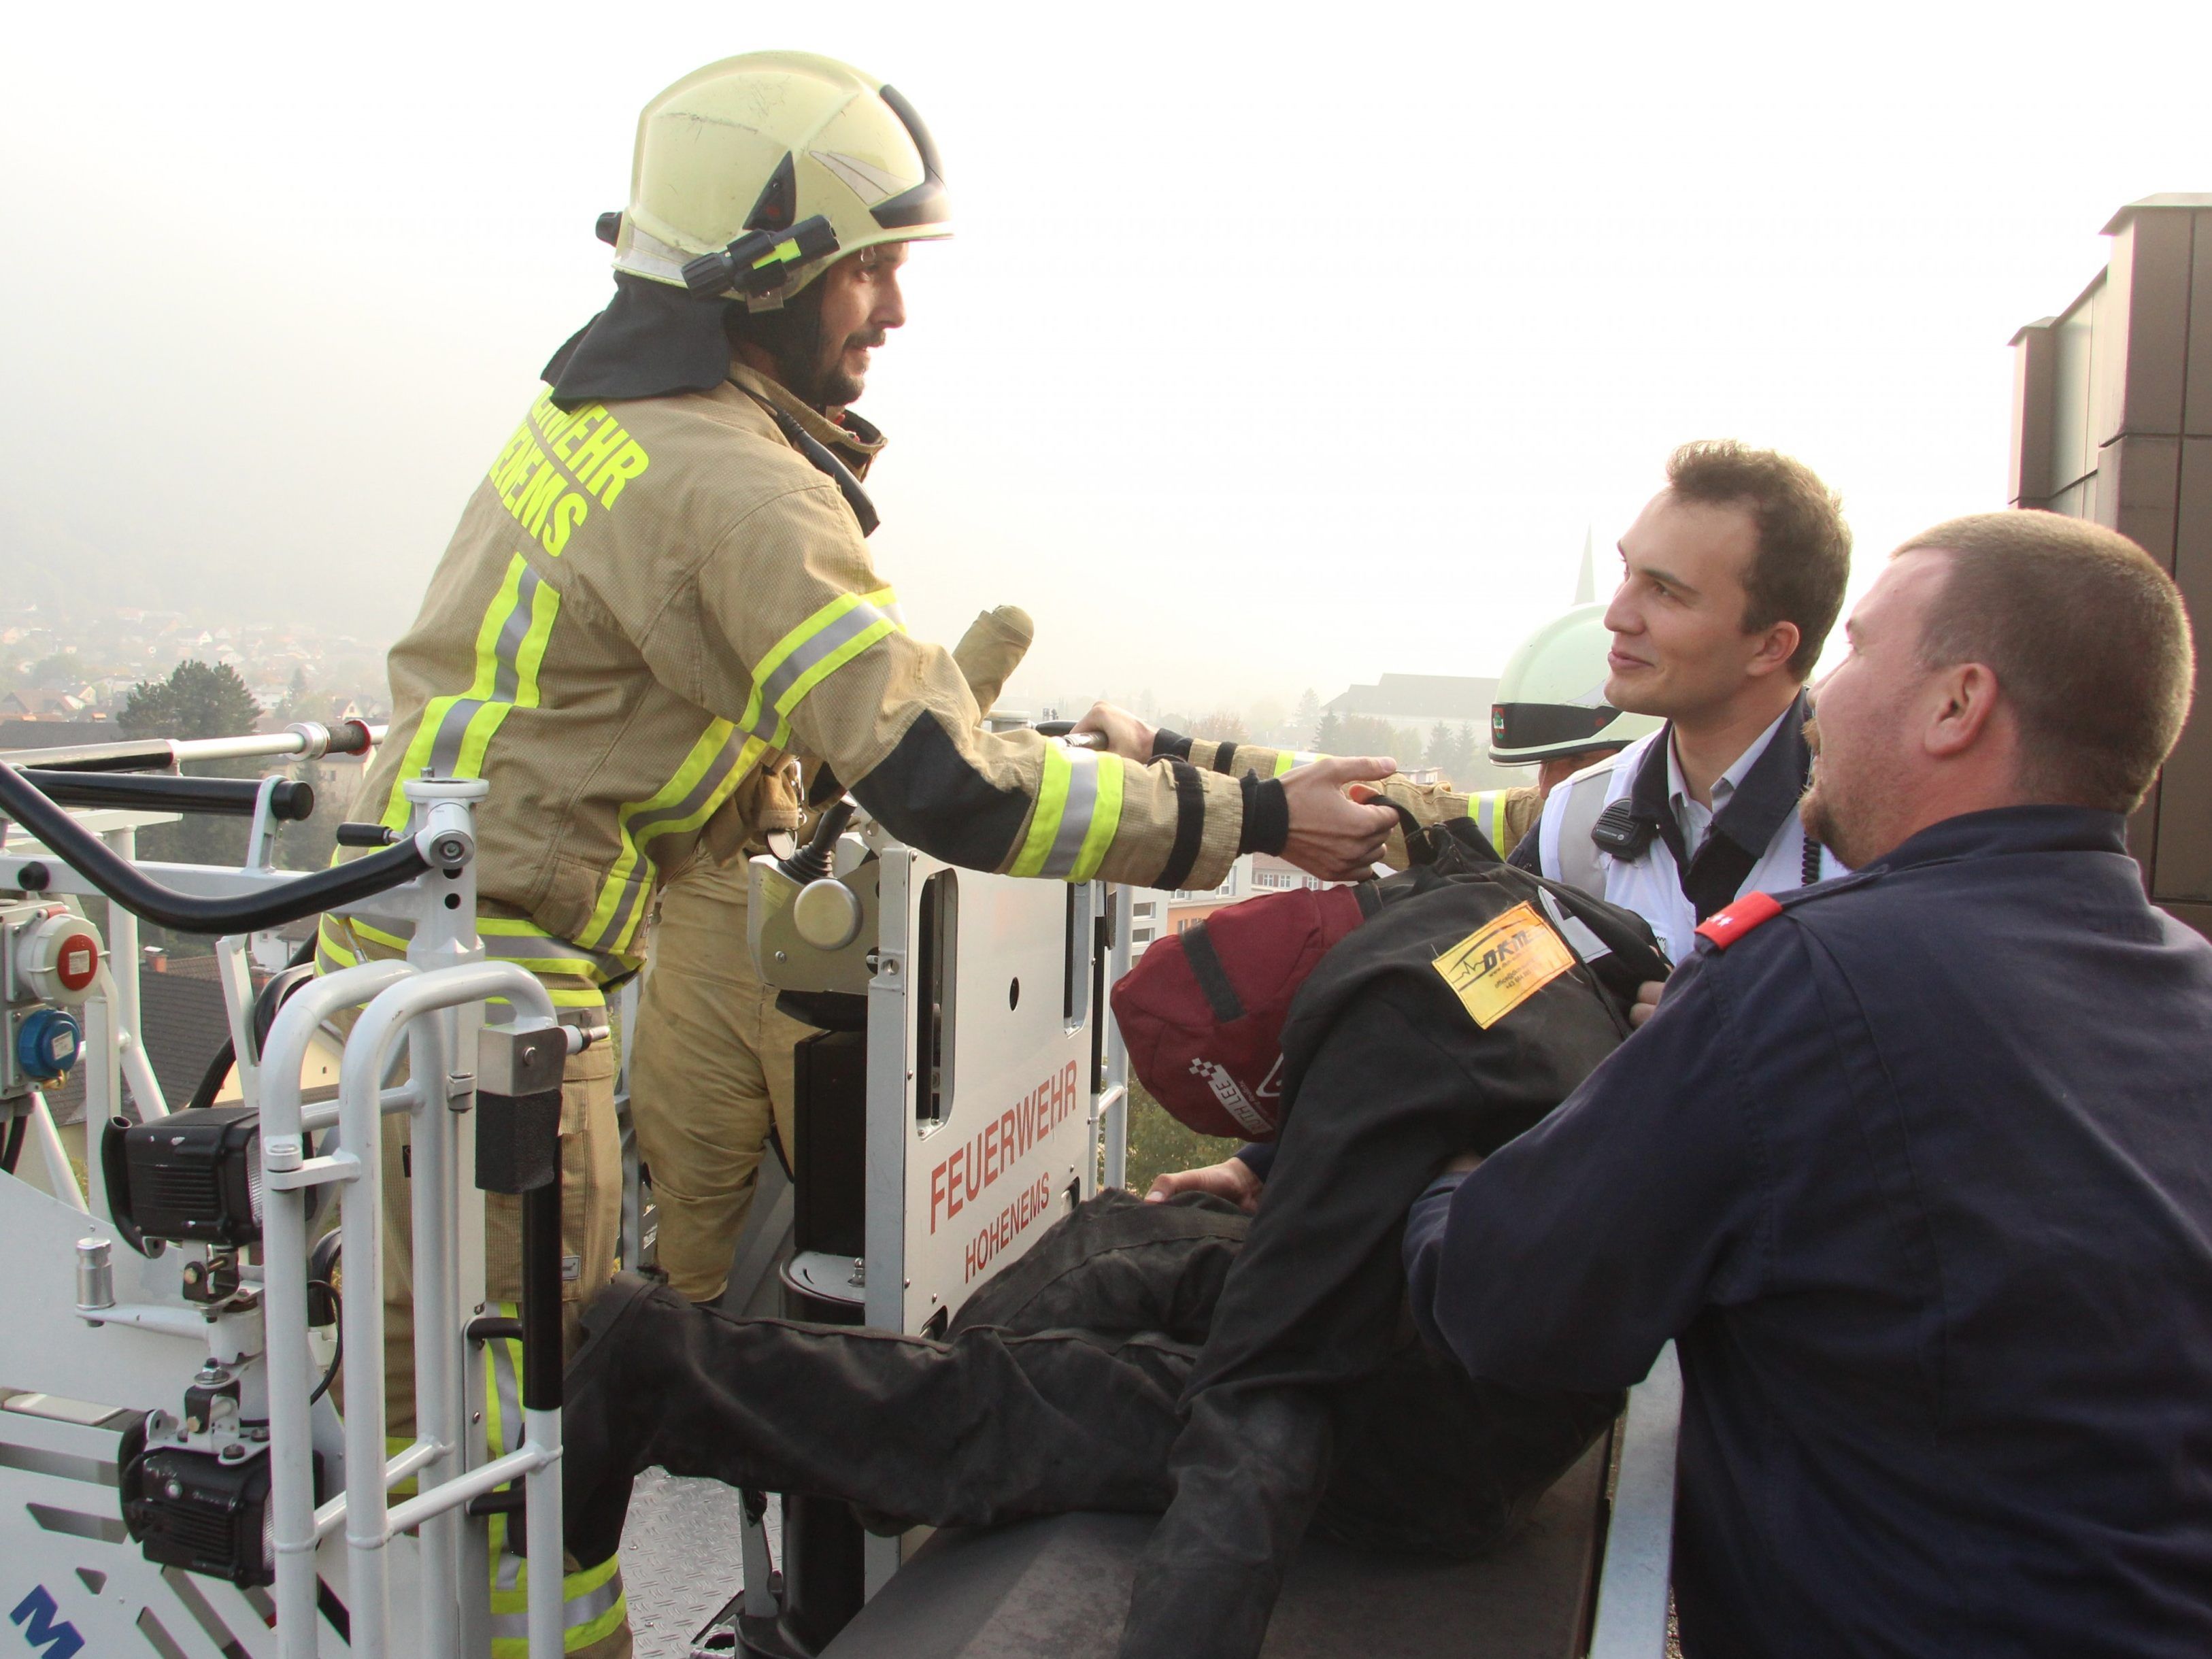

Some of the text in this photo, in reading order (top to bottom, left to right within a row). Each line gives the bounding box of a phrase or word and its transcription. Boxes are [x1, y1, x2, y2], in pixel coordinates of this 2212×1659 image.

[488, 420, 588, 558] ENEMS
[1483, 930, 1529, 972] DKM
[930, 1059, 1077, 1236] FEUERWEHR
[1216, 1080, 1241, 1106] LEE
[965, 1171, 1050, 1285] HOHENEMS
